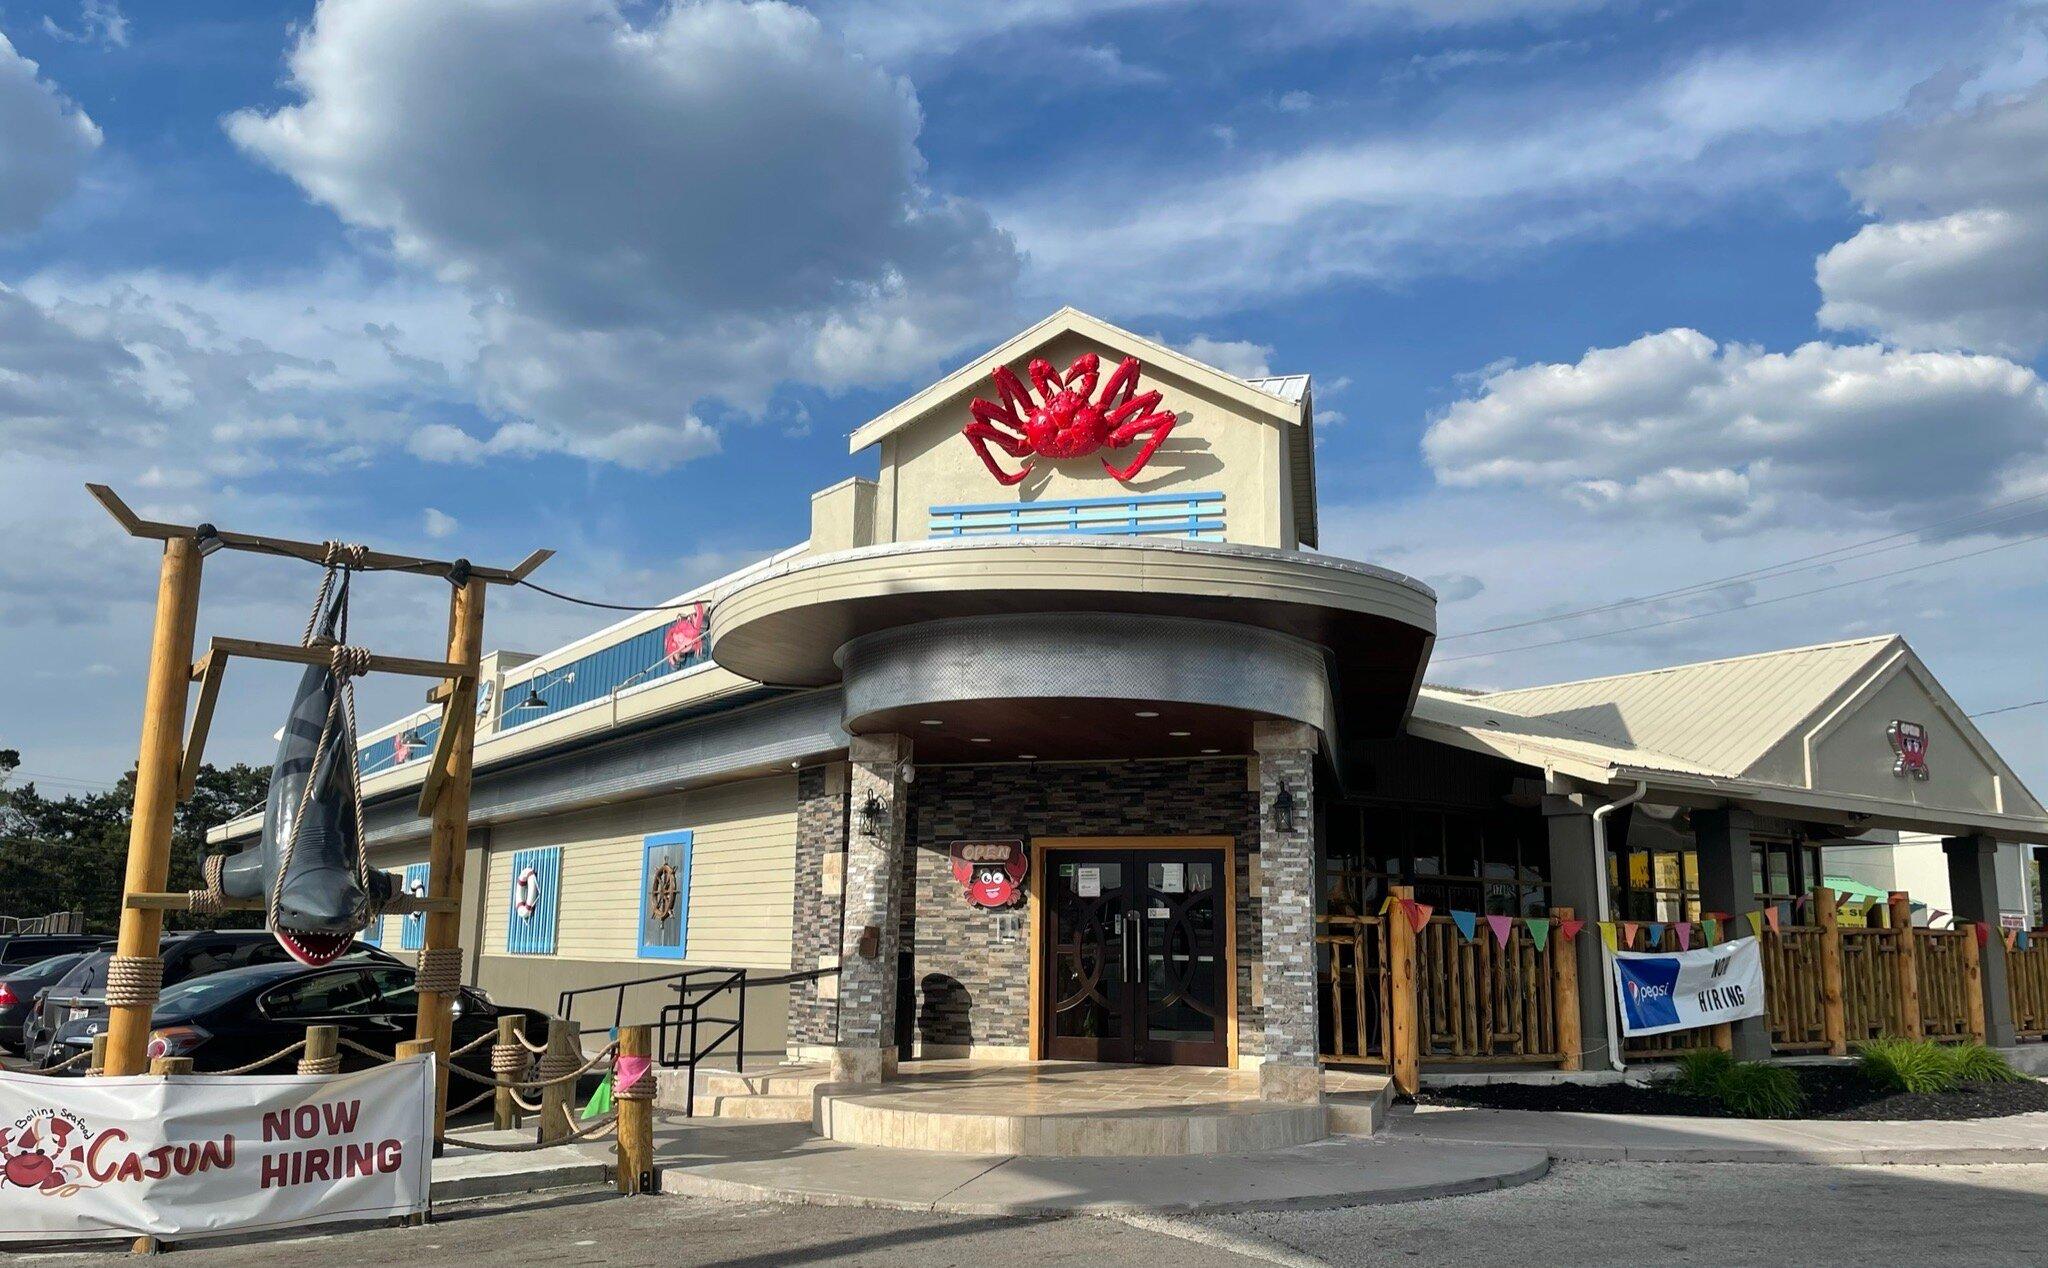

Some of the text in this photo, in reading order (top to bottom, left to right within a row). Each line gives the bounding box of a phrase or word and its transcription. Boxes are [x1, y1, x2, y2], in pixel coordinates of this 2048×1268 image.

[962, 844, 1011, 860] OPEN
[1640, 982, 1669, 1002] pepsi
[1698, 985, 1745, 1012] HIRING
[15, 1108, 95, 1140] Boiling Seafood
[262, 1100, 361, 1142] NOW
[87, 1128, 235, 1183] CAJUN
[260, 1139, 402, 1188] HIRING
